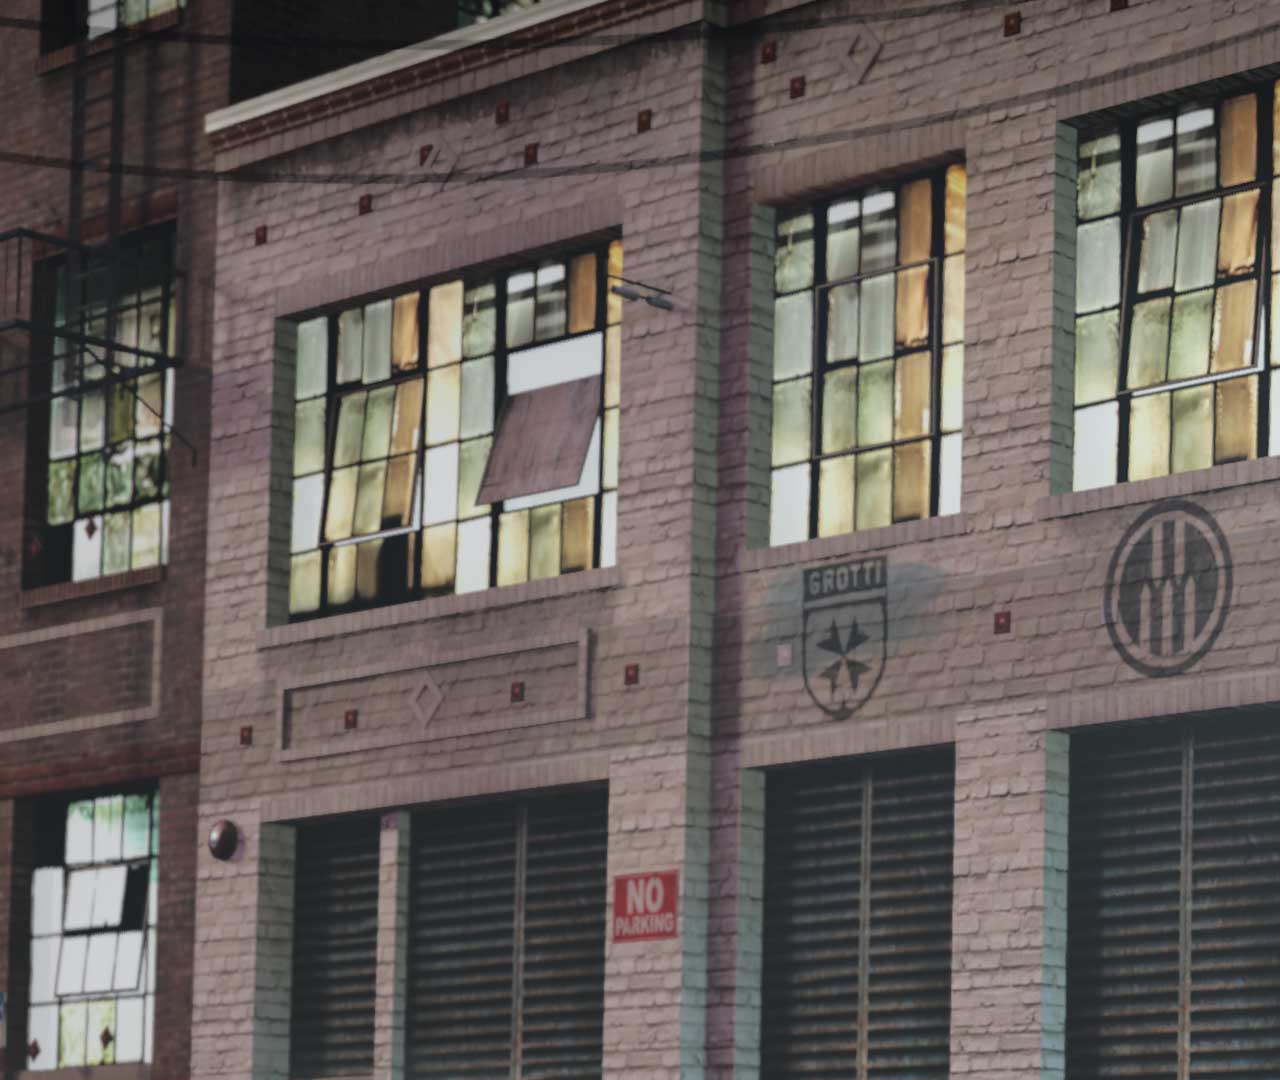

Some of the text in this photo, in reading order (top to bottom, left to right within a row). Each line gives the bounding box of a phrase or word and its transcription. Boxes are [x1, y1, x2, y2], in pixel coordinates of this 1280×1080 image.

[808, 559, 883, 596] GROTTI
[626, 877, 665, 915] NO
[615, 912, 674, 936] PARKING
